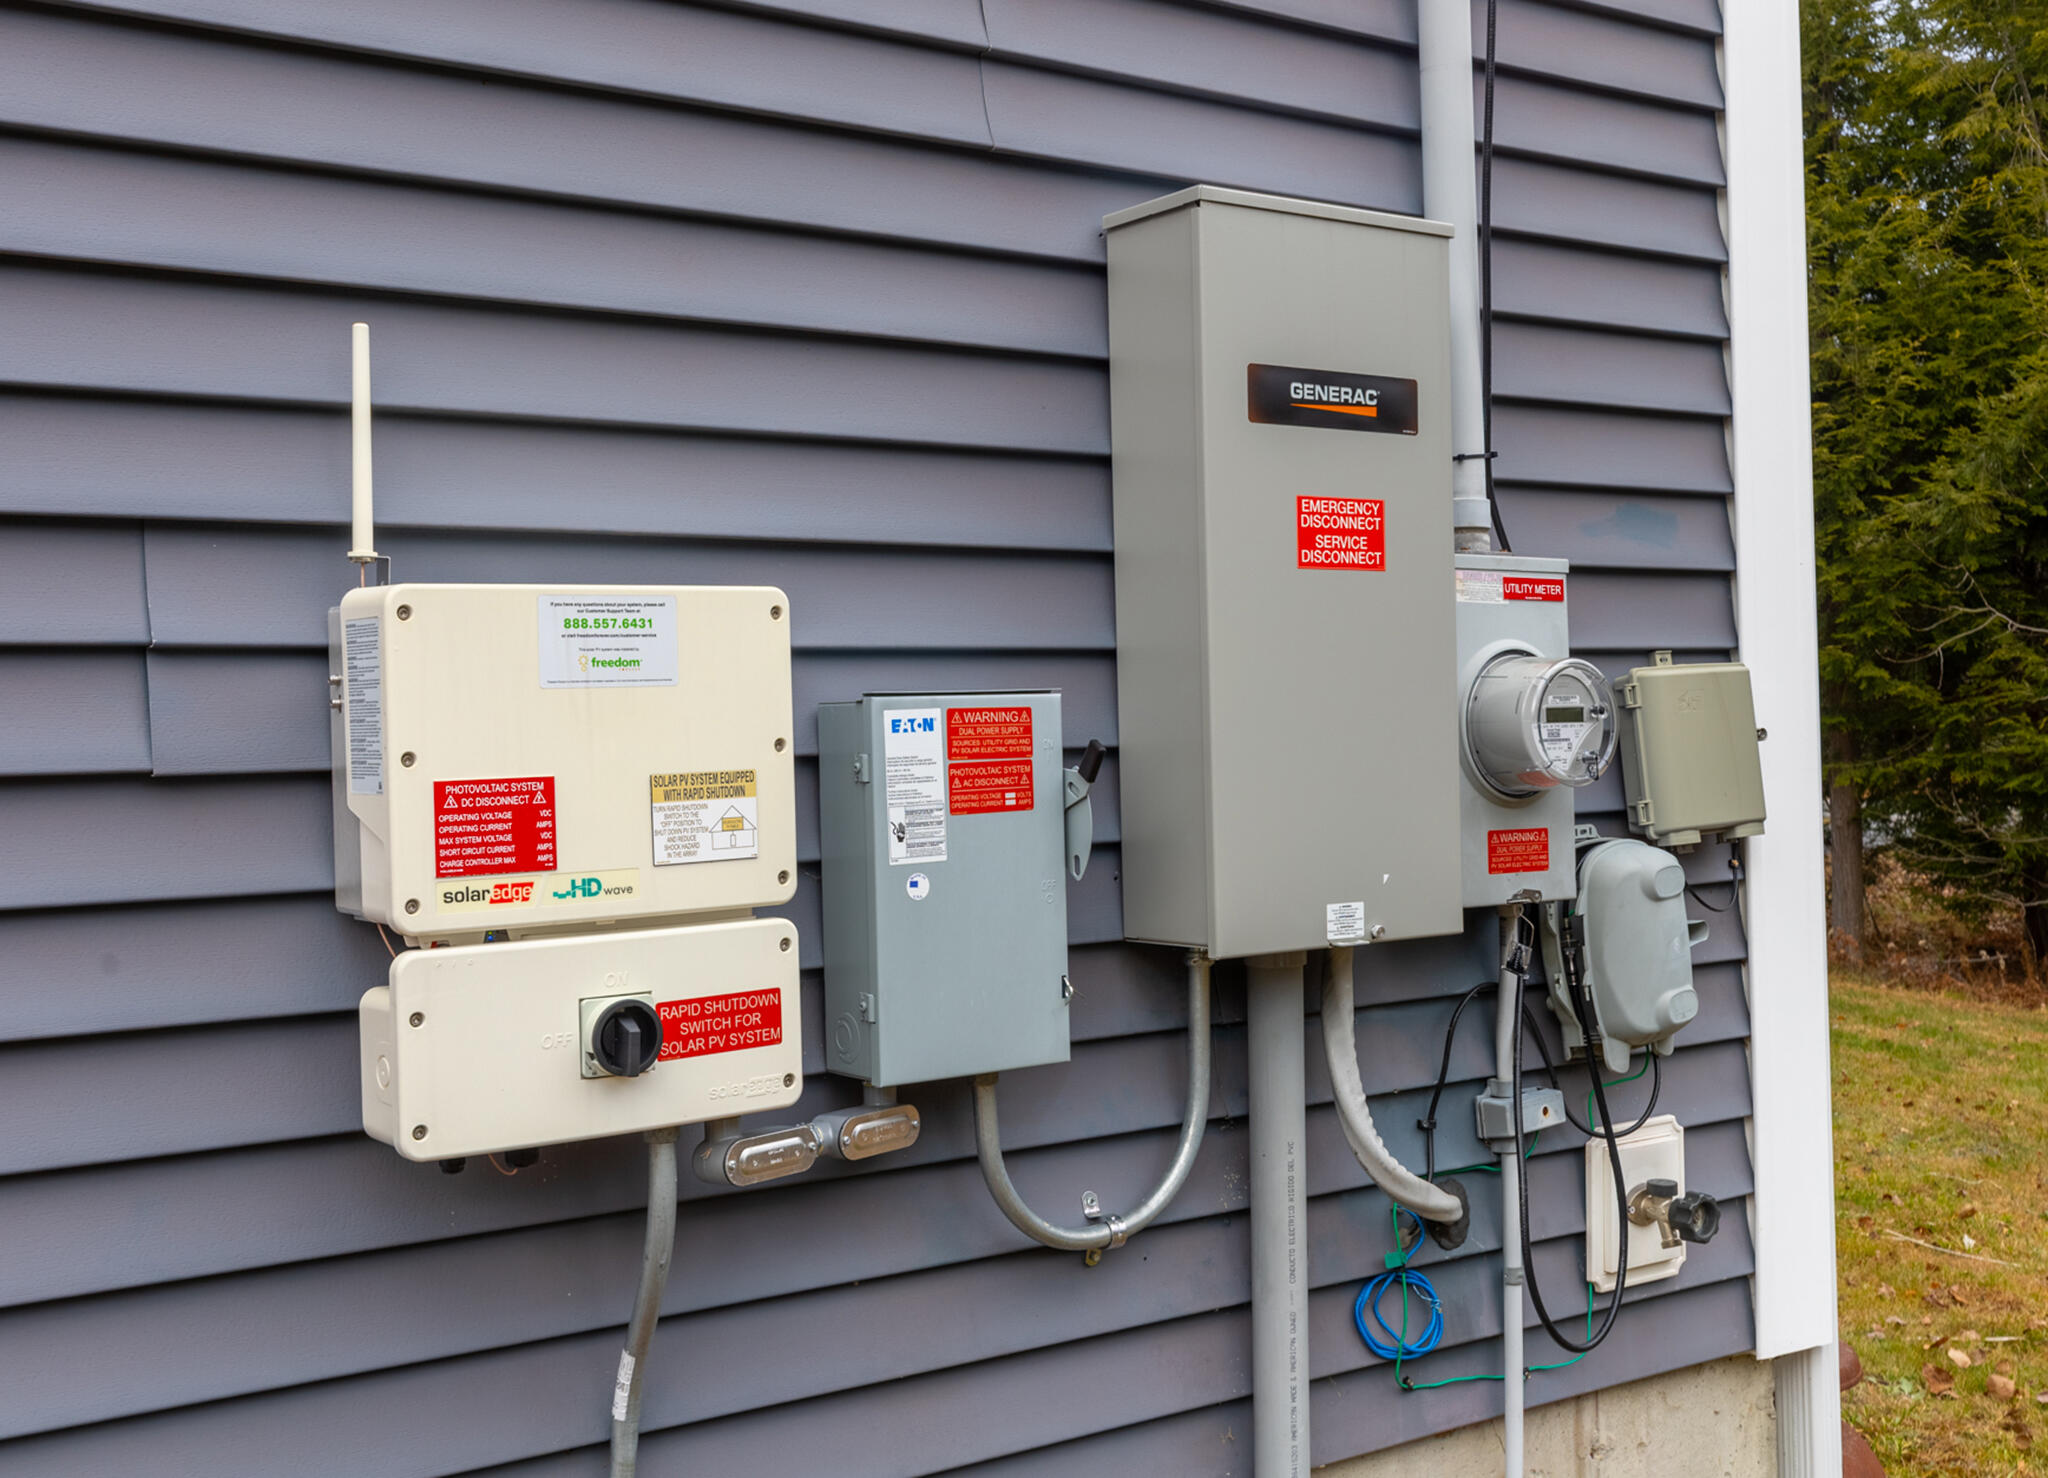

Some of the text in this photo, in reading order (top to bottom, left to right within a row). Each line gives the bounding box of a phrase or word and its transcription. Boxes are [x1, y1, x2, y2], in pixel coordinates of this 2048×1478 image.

[1290, 382, 1378, 406] GENERAC
[1302, 499, 1380, 515] EMERGENCY
[1300, 514, 1381, 530] DISCONNECT
[1315, 534, 1368, 550] SERVICE
[1302, 550, 1382, 565] DISCONNECT
[1504, 584, 1562, 595] UTILITY METER
[564, 618, 653, 629] 888.557.6431
[591, 657, 640, 668] freedom
[964, 711, 1019, 723] WARNING
[959, 726, 1024, 735] DUAL POWER SUPPLY
[950, 765, 1031, 777] PHOTOVOLTAIC SYSTEM
[654, 770, 755, 788] SOLAR PV SYSTEM EQUIPPED
[964, 776, 1019, 787] AC DISCONNECT
[446, 782, 544, 795] PHOTOVOLTAIC SYSTEM
[664, 785, 746, 801] WITH RAPID SHUTDOWN
[461, 795, 529, 807] DC DISCONNECT
[951, 794, 979, 802] OPERATING
[981, 800, 1003, 808] CURRENT
[438, 809, 552, 823] OPERATING VOLTAGE VDC
[438, 820, 552, 834] OPERATING CURRENT AMPS
[455, 836, 482, 844] SYSTEM
[483, 834, 512, 842] VOLTAGE
[540, 832, 552, 840] VDC
[1500, 832, 1539, 843] WARNING
[440, 843, 553, 857] SHORT CIRCUIT CURRENT AMPS
[440, 854, 553, 868] CHARGE CONTROLLER MAX AMPS
[444, 882, 534, 904] solaredge
[604, 886, 633, 896] wave
[604, 971, 629, 987] ON
[660, 993, 779, 1020] RAPID SHUTDOWN
[680, 1013, 762, 1036] SWITCH FOR
[541, 1032, 573, 1050] OFF
[660, 1027, 781, 1056] SOLAR PV SYSTEM
[1288, 1248, 1296, 1284] CONDUCTO
